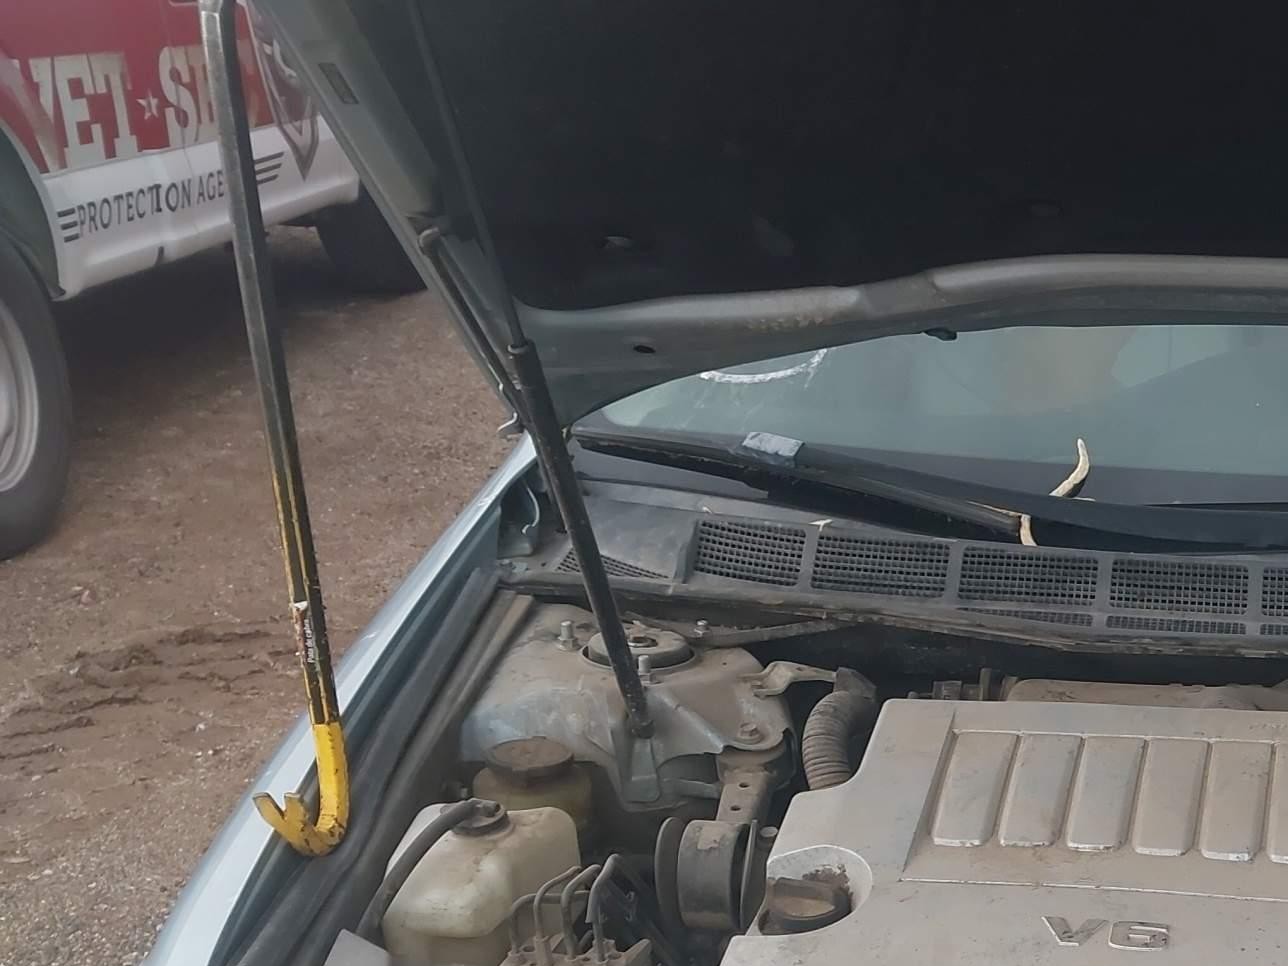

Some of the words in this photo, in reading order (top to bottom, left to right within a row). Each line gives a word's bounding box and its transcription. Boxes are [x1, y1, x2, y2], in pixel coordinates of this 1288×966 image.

[0, 52, 138, 172] VET
[76, 178, 192, 237] PROTECTION
[196, 169, 226, 205] AGE
[1040, 915, 1170, 952] V6
